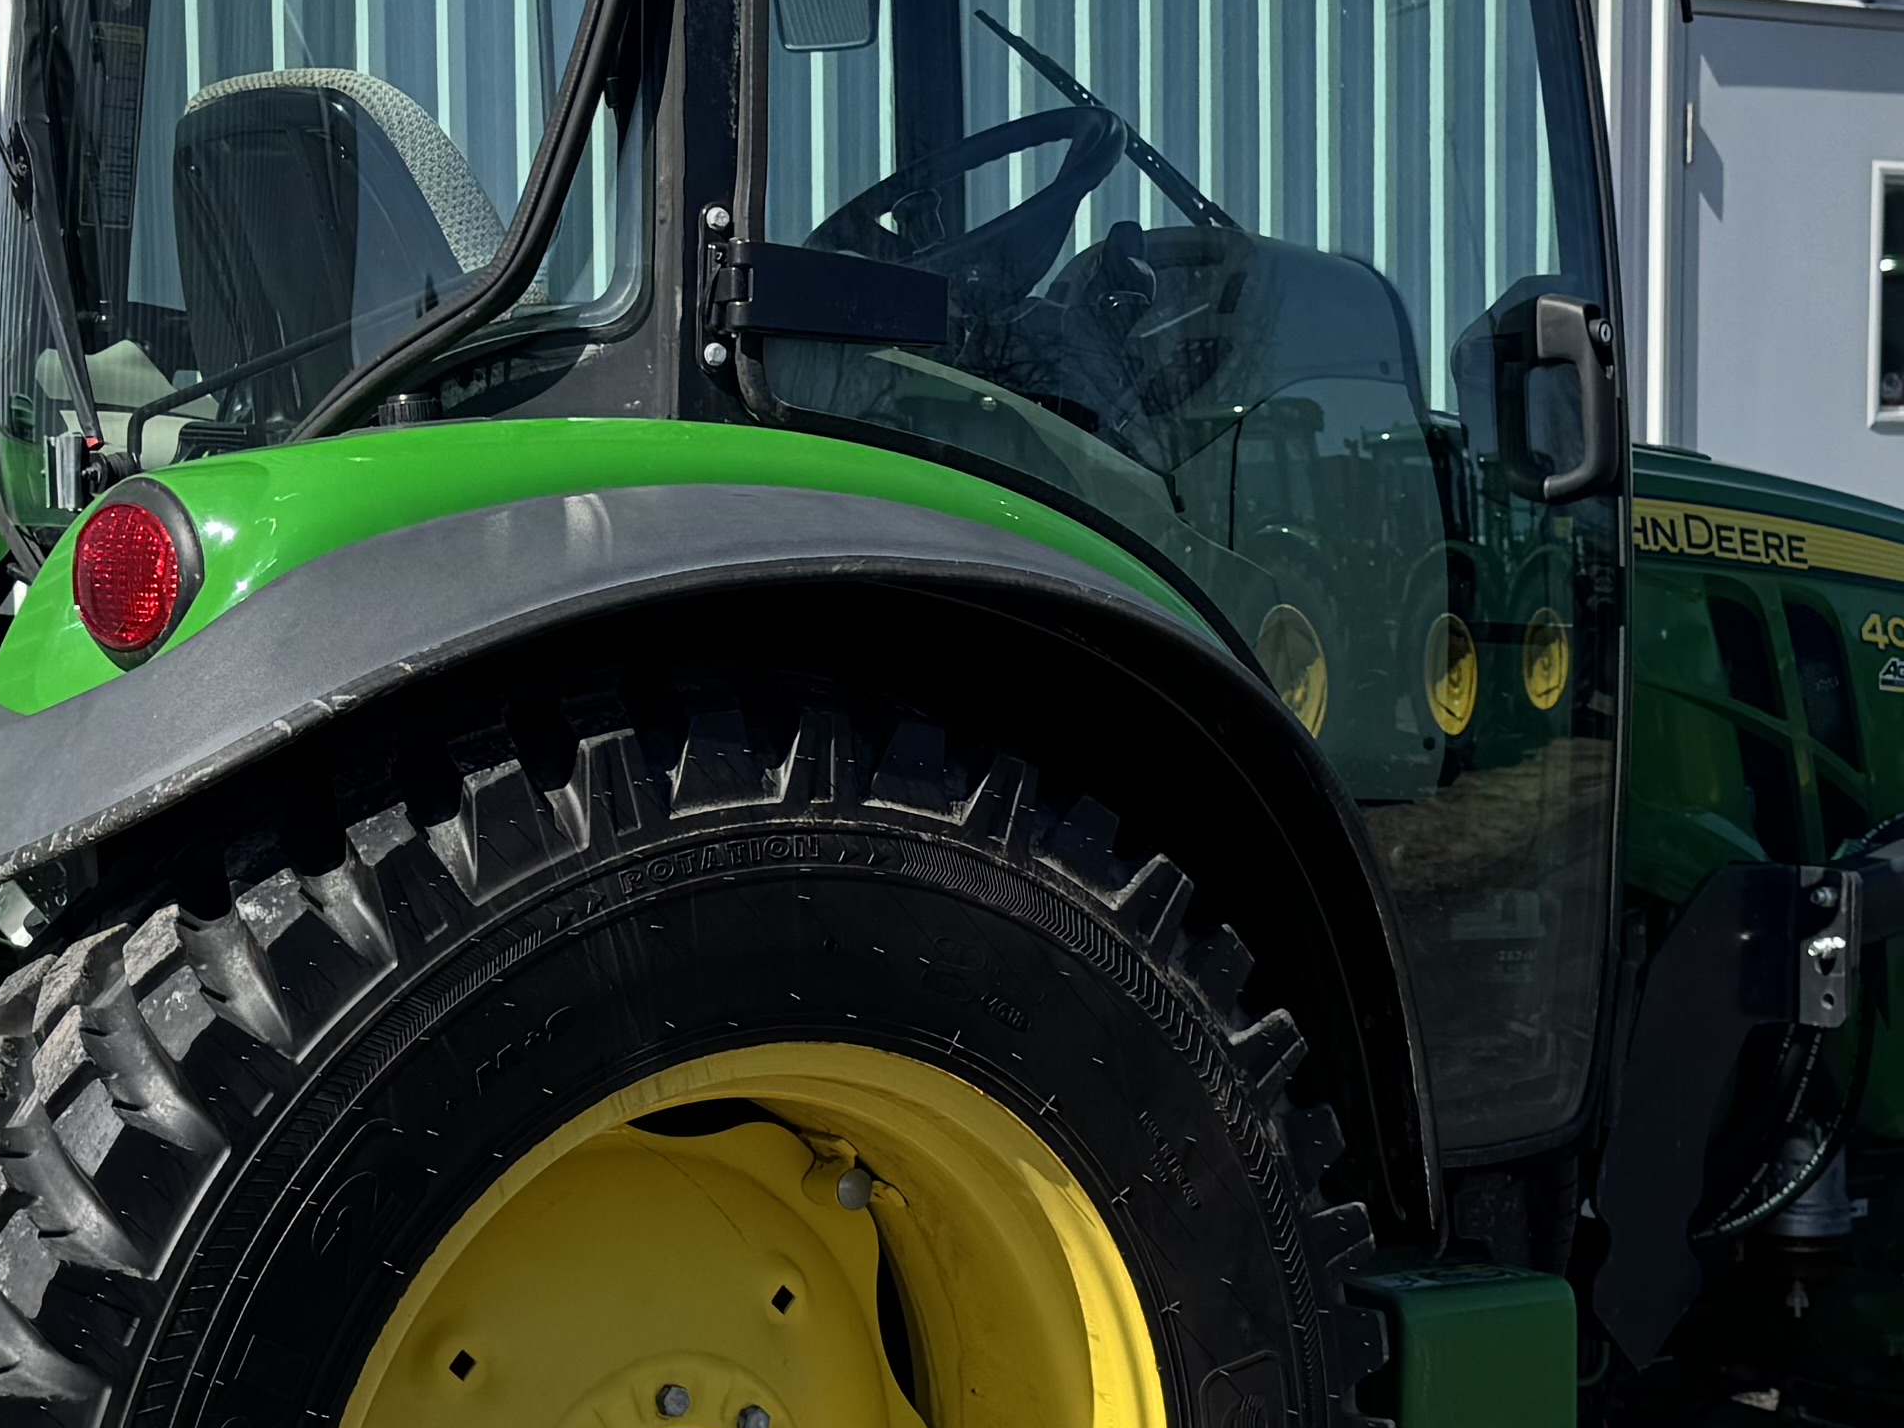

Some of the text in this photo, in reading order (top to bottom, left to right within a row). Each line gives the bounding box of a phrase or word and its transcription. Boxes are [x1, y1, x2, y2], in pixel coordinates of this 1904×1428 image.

[1633, 513, 1809, 564] HN DEERE
[619, 834, 821, 896] ROTATION
